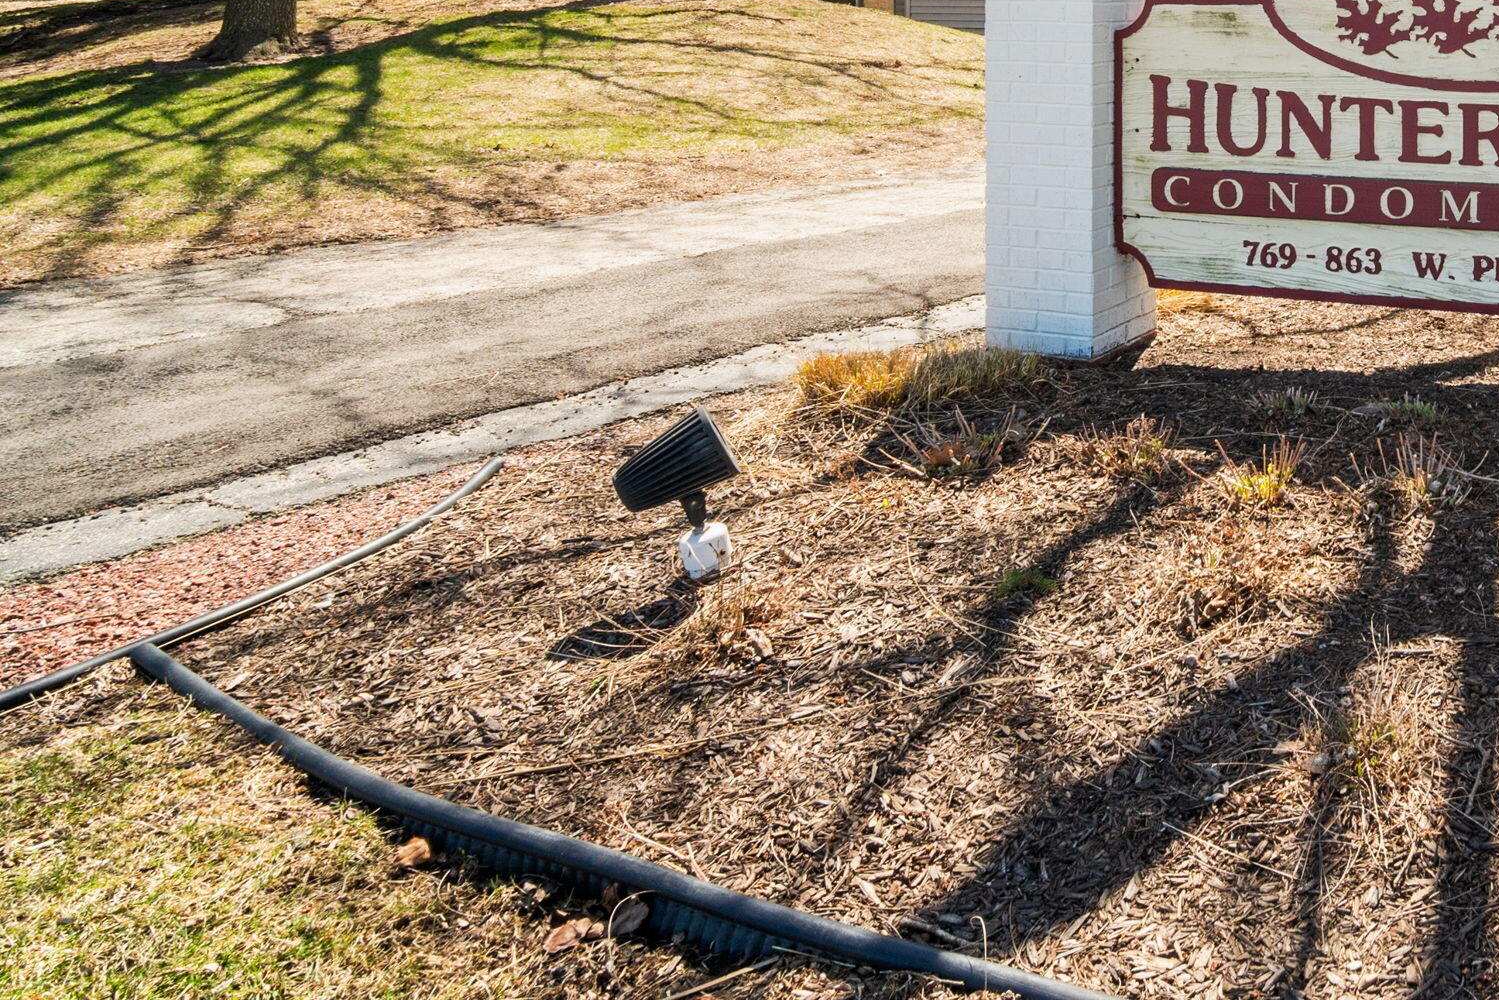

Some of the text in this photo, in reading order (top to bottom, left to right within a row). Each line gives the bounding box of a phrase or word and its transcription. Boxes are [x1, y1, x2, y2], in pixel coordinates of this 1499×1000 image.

[1243, 240, 1297, 269] 769
[1325, 246, 1382, 275] 863
[1412, 251, 1455, 281] W.
